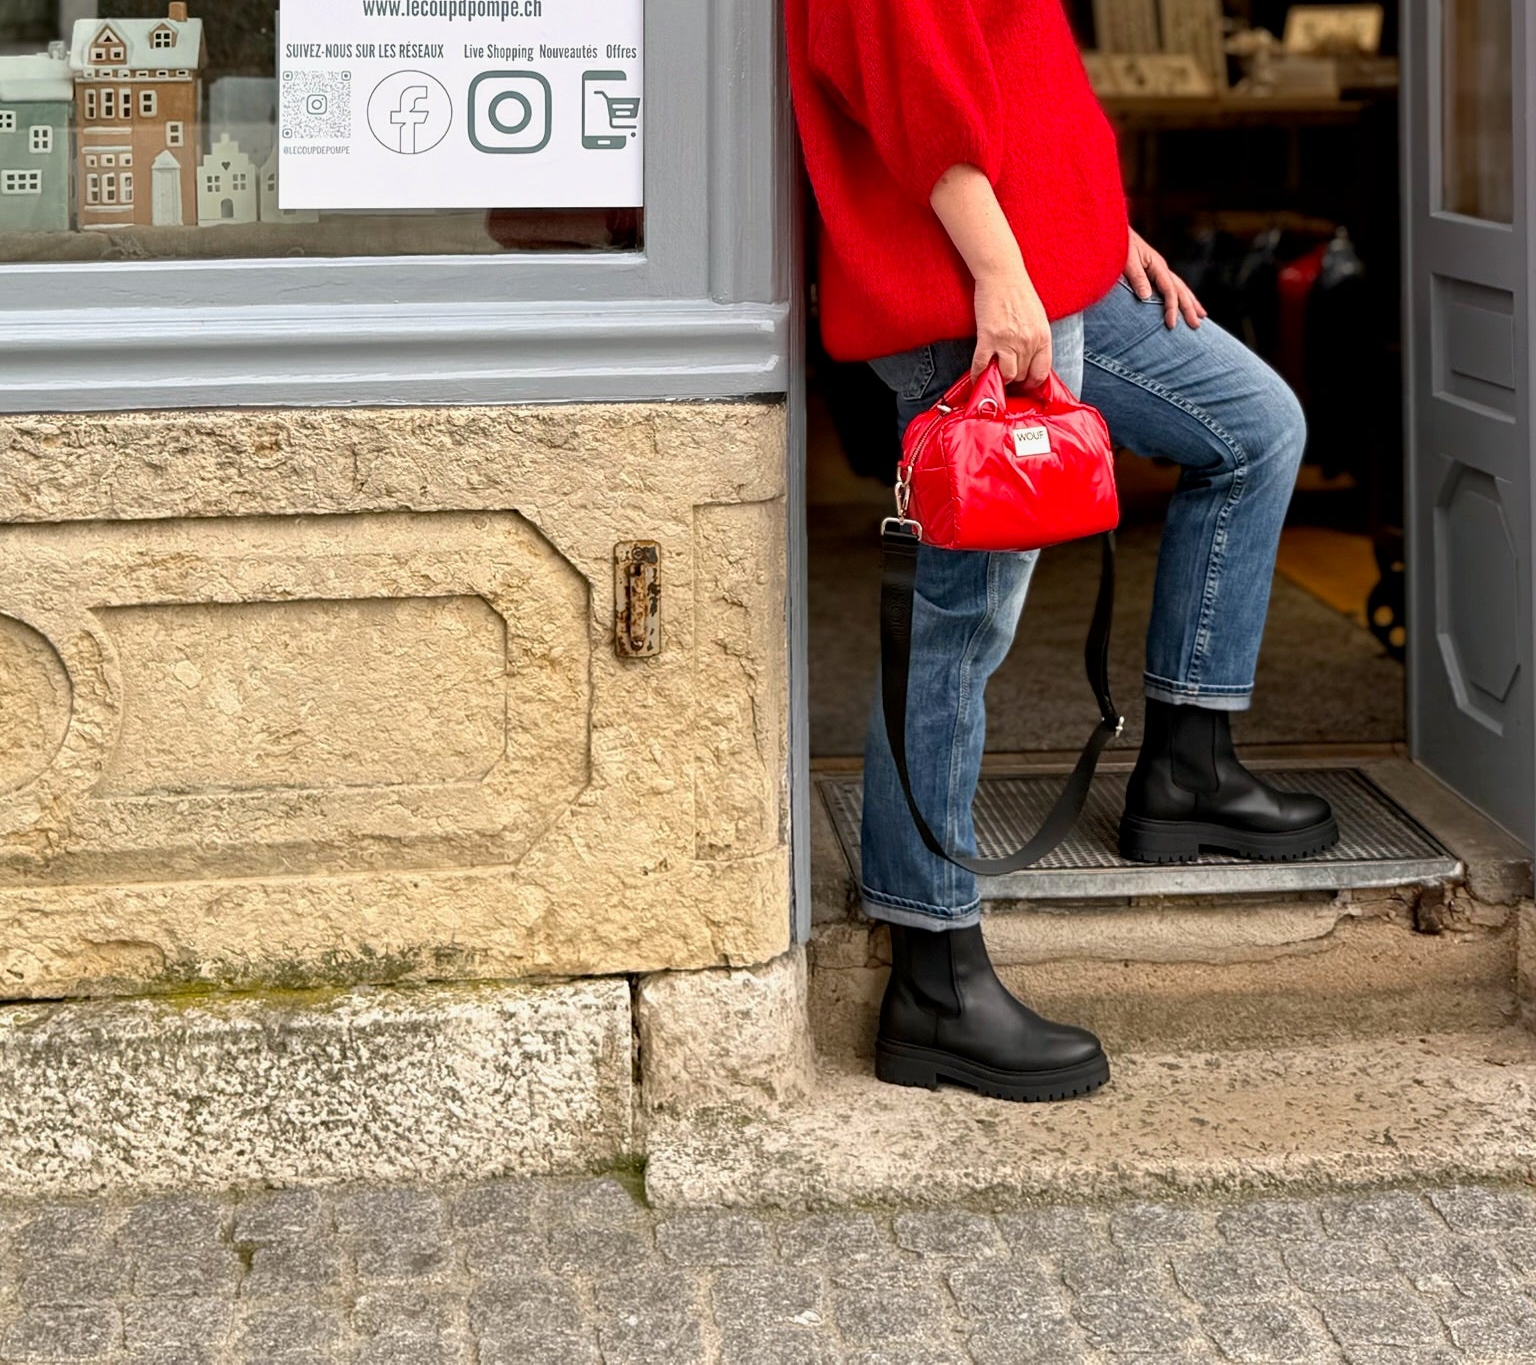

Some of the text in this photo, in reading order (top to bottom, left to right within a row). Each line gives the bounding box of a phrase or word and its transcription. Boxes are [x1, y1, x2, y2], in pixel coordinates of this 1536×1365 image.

[285, 41, 444, 58] SUIVEZ-NOUS SUR LES RÉSEAUX
[464, 44, 637, 62] Live Shopping Nouveautés Offres
[1016, 430, 1044, 442] WOUF
